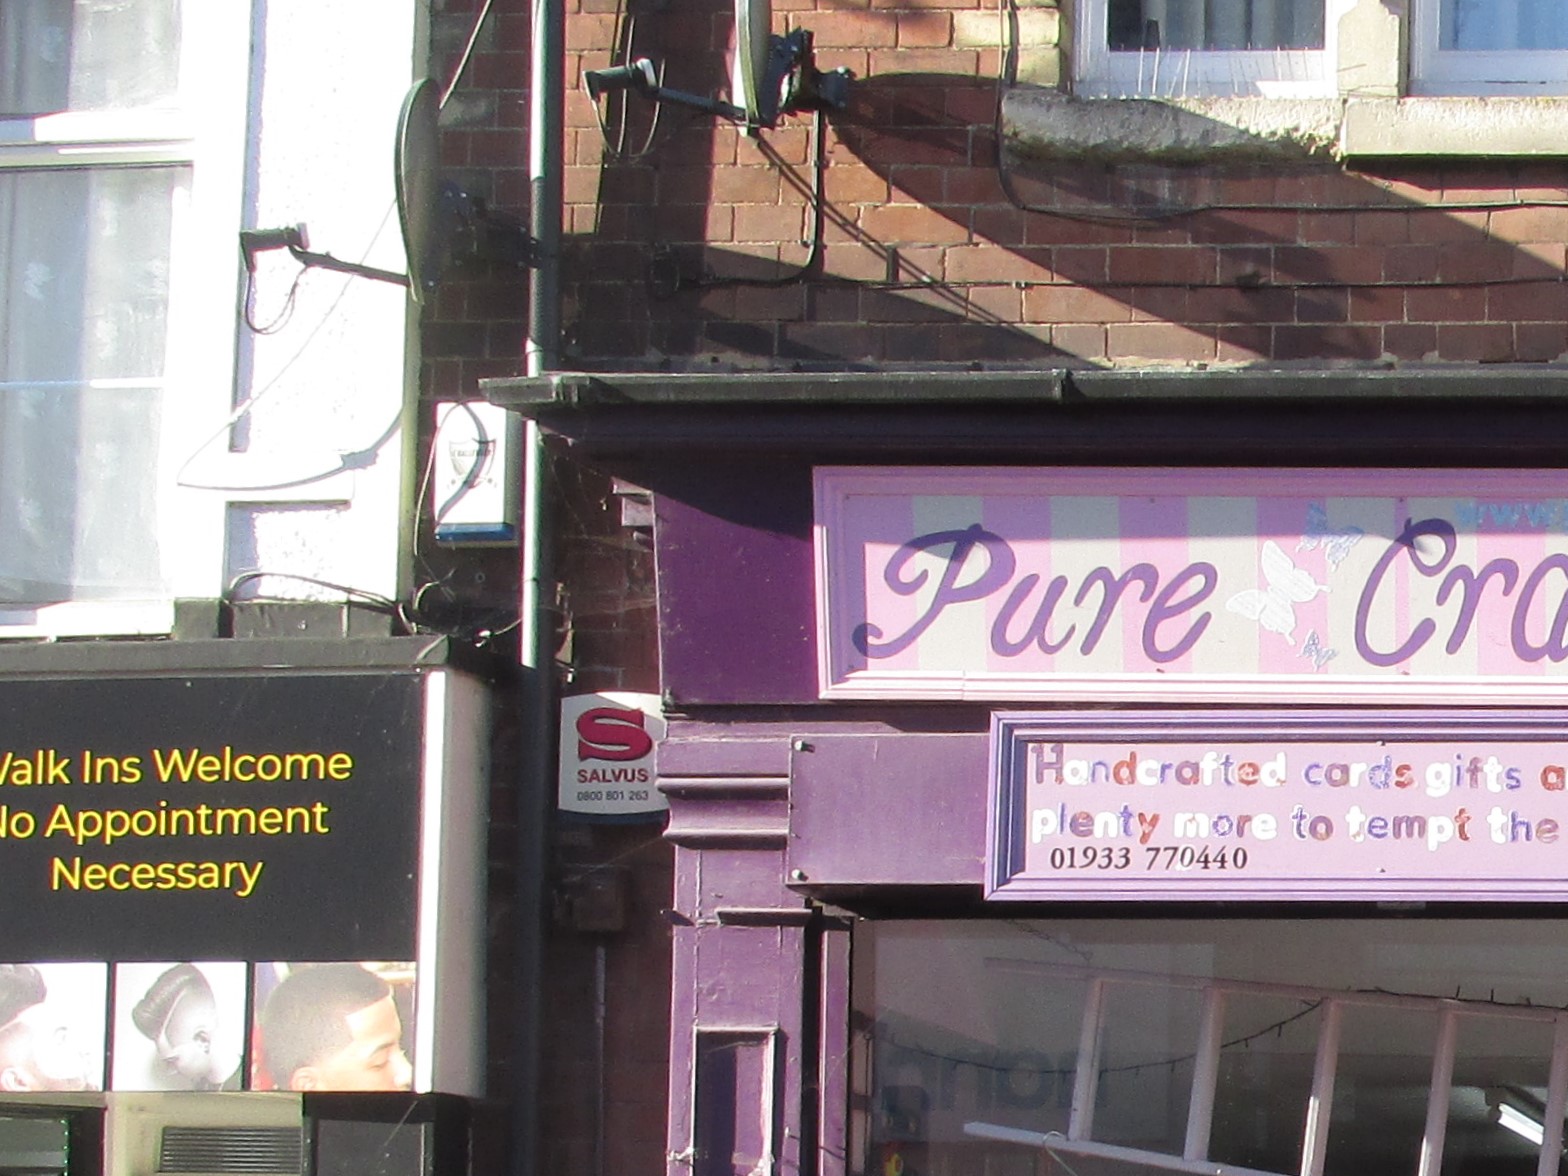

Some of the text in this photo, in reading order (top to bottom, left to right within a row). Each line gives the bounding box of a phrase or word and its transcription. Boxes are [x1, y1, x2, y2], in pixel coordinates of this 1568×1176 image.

[852, 523, 1218, 660] Pure
[0, 746, 354, 785] alk Ins Welcome
[577, 768, 650, 783] SALVUS
[1030, 743, 1288, 788] Handcrafted
[1303, 755, 1415, 790] cards
[1424, 752, 1523, 797] gifts
[577, 790, 649, 801] 0800 801 263
[45, 801, 330, 846] Appointment
[1030, 802, 1161, 844] plenty
[1173, 811, 1278, 841] more
[1290, 804, 1335, 841] to
[1345, 805, 1472, 852] tempt
[1486, 805, 1560, 844] the
[52, 855, 264, 897] Necessary
[1050, 843, 1248, 870] 01933 770440
